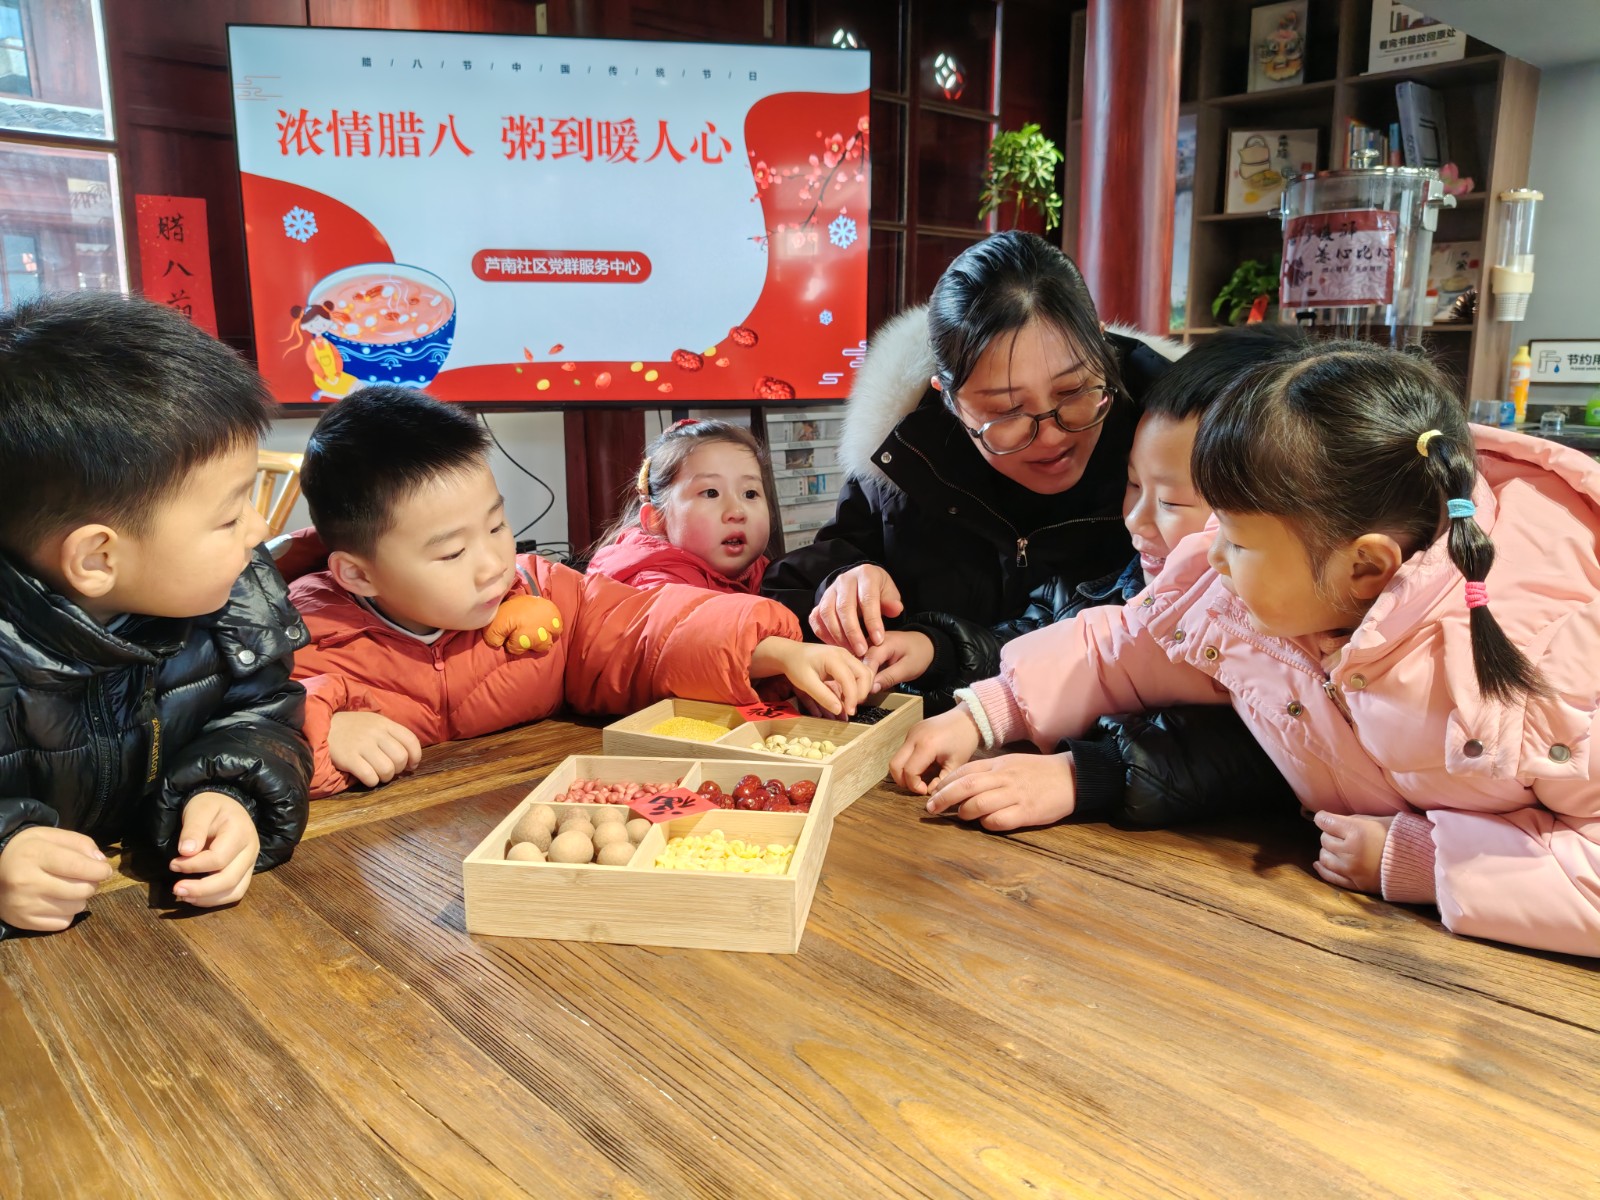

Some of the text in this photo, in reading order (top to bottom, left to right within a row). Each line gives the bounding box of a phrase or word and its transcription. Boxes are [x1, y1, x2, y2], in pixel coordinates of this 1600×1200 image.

[276, 108, 732, 165] 浓情腊八 粥到暖人心
[484, 256, 641, 276] 芦南社区党群服务中心
